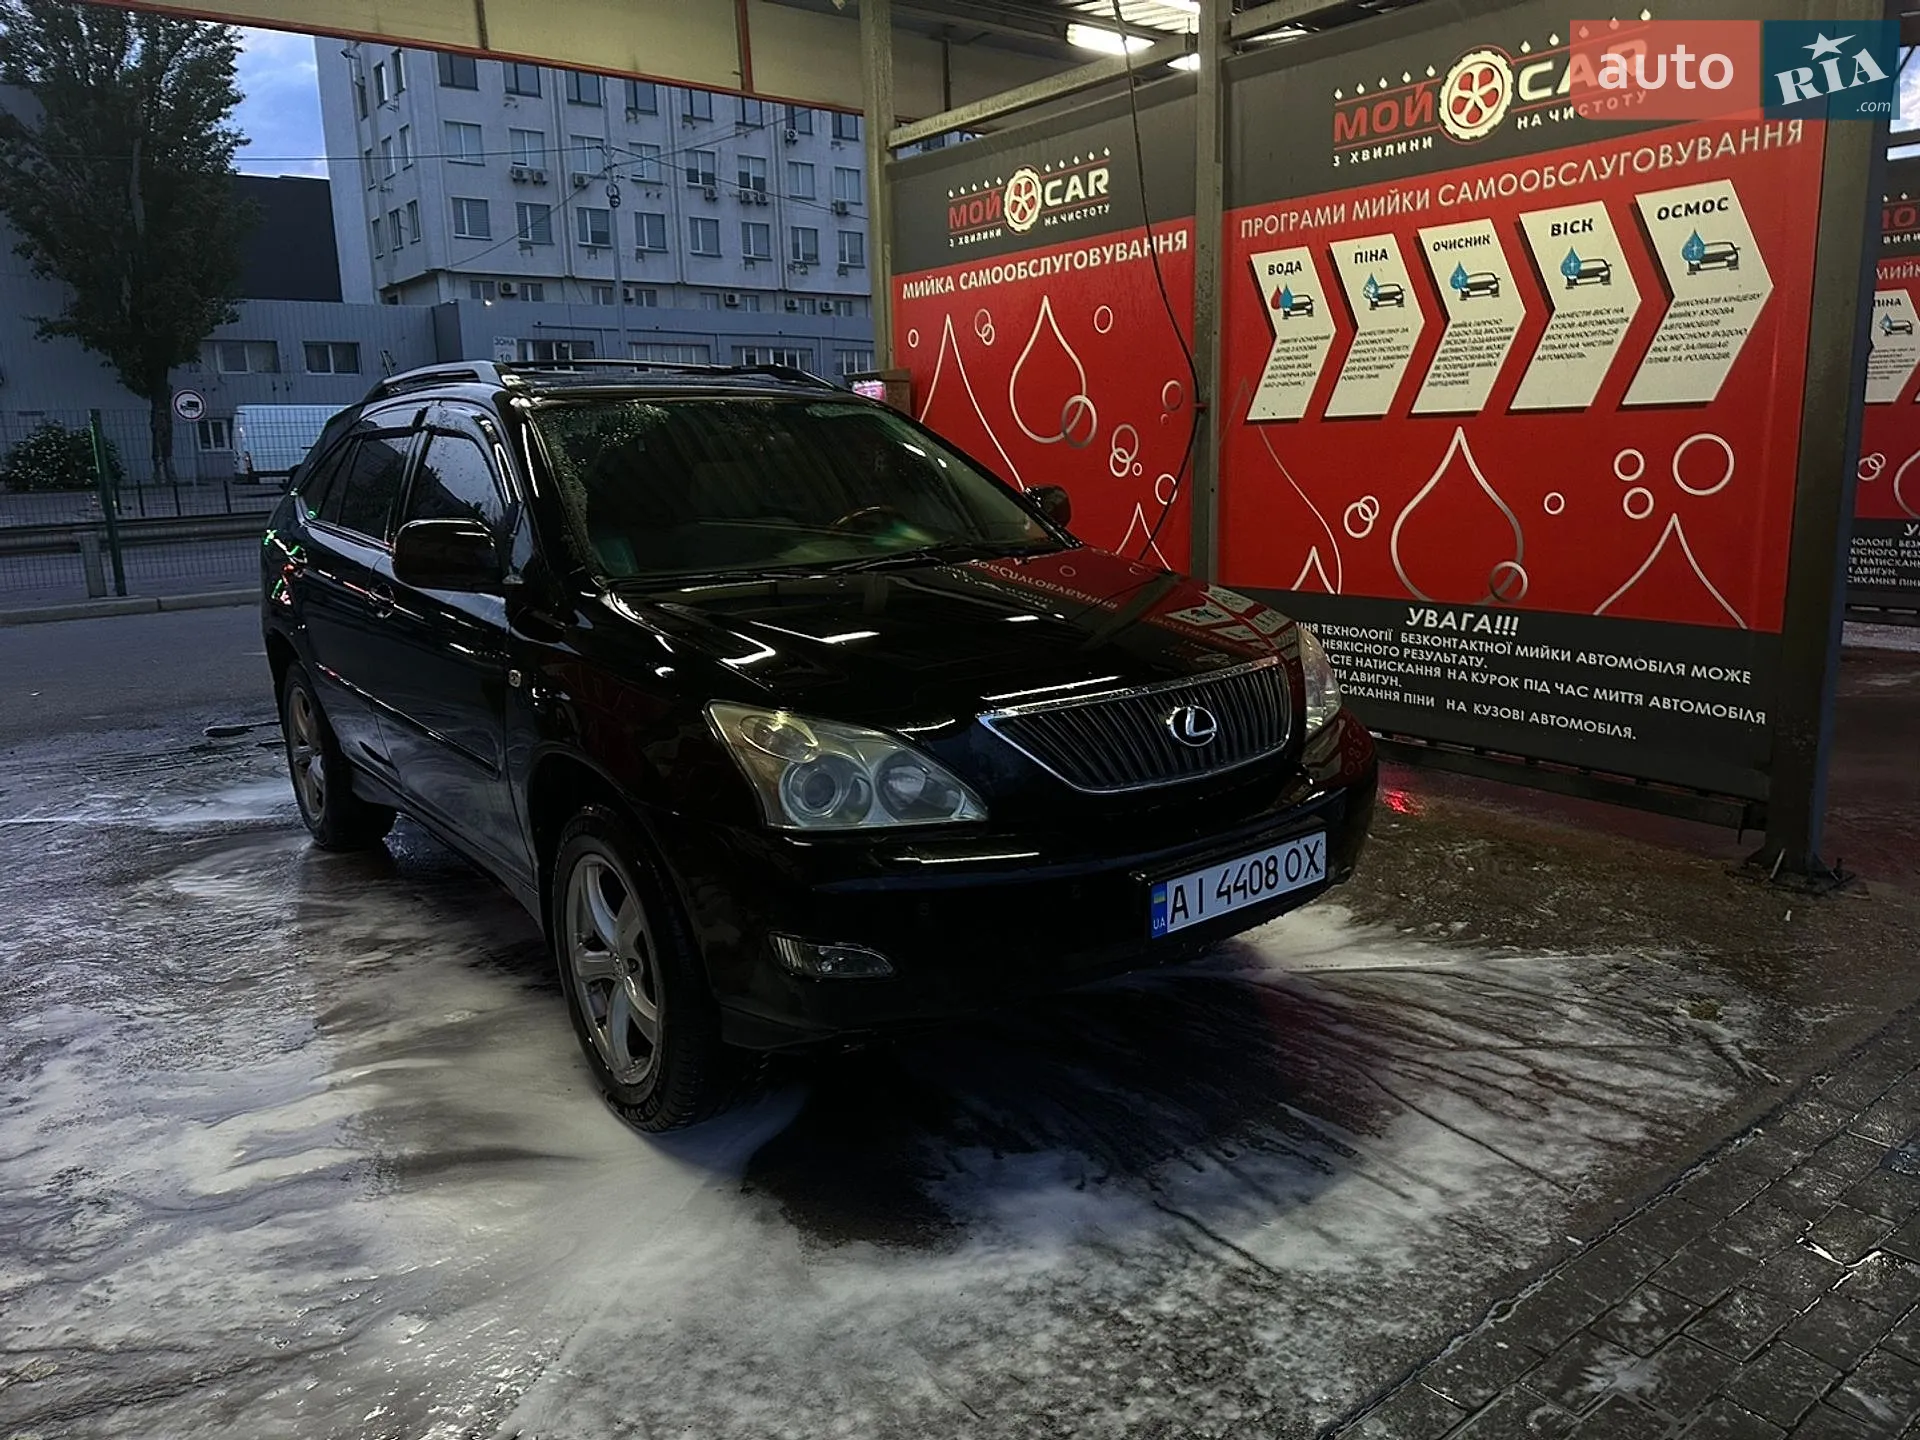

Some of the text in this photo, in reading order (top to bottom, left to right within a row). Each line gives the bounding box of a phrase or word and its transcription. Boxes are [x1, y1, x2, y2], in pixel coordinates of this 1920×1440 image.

[1334, 38, 1648, 143] МОЙ CAR
[1350, 136, 1433, 164] ХВИЛИНИ
[1517, 115, 1543, 130] НА
[1549, 90, 1647, 123] ЧИСТОТУ
[948, 167, 1109, 229] МОЙ CAR
[1241, 119, 1803, 239] ПРОГРАМИ МИЙКИ САМООБСЛУГОВУВАННЯ
[958, 228, 1002, 246] ХВИЛИНИ
[1044, 217, 1059, 227] НА
[1061, 203, 1110, 223] ЧИСТОТУ
[1550, 218, 1594, 236] ВІСК
[1657, 197, 1729, 221] ОСМОС
[903, 229, 1188, 300] МИЙКА САМООБСЛУГОВУВАННЯ
[1354, 248, 1388, 264] ПІНА
[1432, 234, 1491, 252] ОЧИСНИК
[1268, 260, 1303, 276] ВОДА
[1405, 607, 1519, 637] УВАГА!!!
[1321, 638, 1488, 669] НЕЯКІСНОГО РЕЗУЛЬТАТУ.
[1321, 623, 1394, 642] ТЕХНОЛОГІЇ
[1400, 632, 1512, 656] БЕЗКОНТАКТНОЇ
[1515, 644, 1571, 662] МИЙКИ
[1576, 651, 1685, 676] АВТОМОБІЛЯ
[1691, 664, 1751, 685] МОЖЕ
[1350, 670, 1402, 687] ДВИГУН.
[1355, 657, 1441, 678] НАТИСКАННЯ
[1447, 669, 1467, 682] НА
[1471, 672, 1519, 689] КУРОК
[1523, 678, 1550, 694] ПІД
[1554, 681, 1589, 697] ЧАС
[1593, 687, 1643, 706] МИТТЯ
[1648, 695, 1766, 725] АВТОМОБІЛЯ
[1340, 683, 1637, 740] СИХАННЯ ПІНИ НА КУЗОВІ АВТОМОБІЛЯ.
[1170, 839, 1322, 924] AI 4408 OX
[1153, 917, 1167, 930] UA
